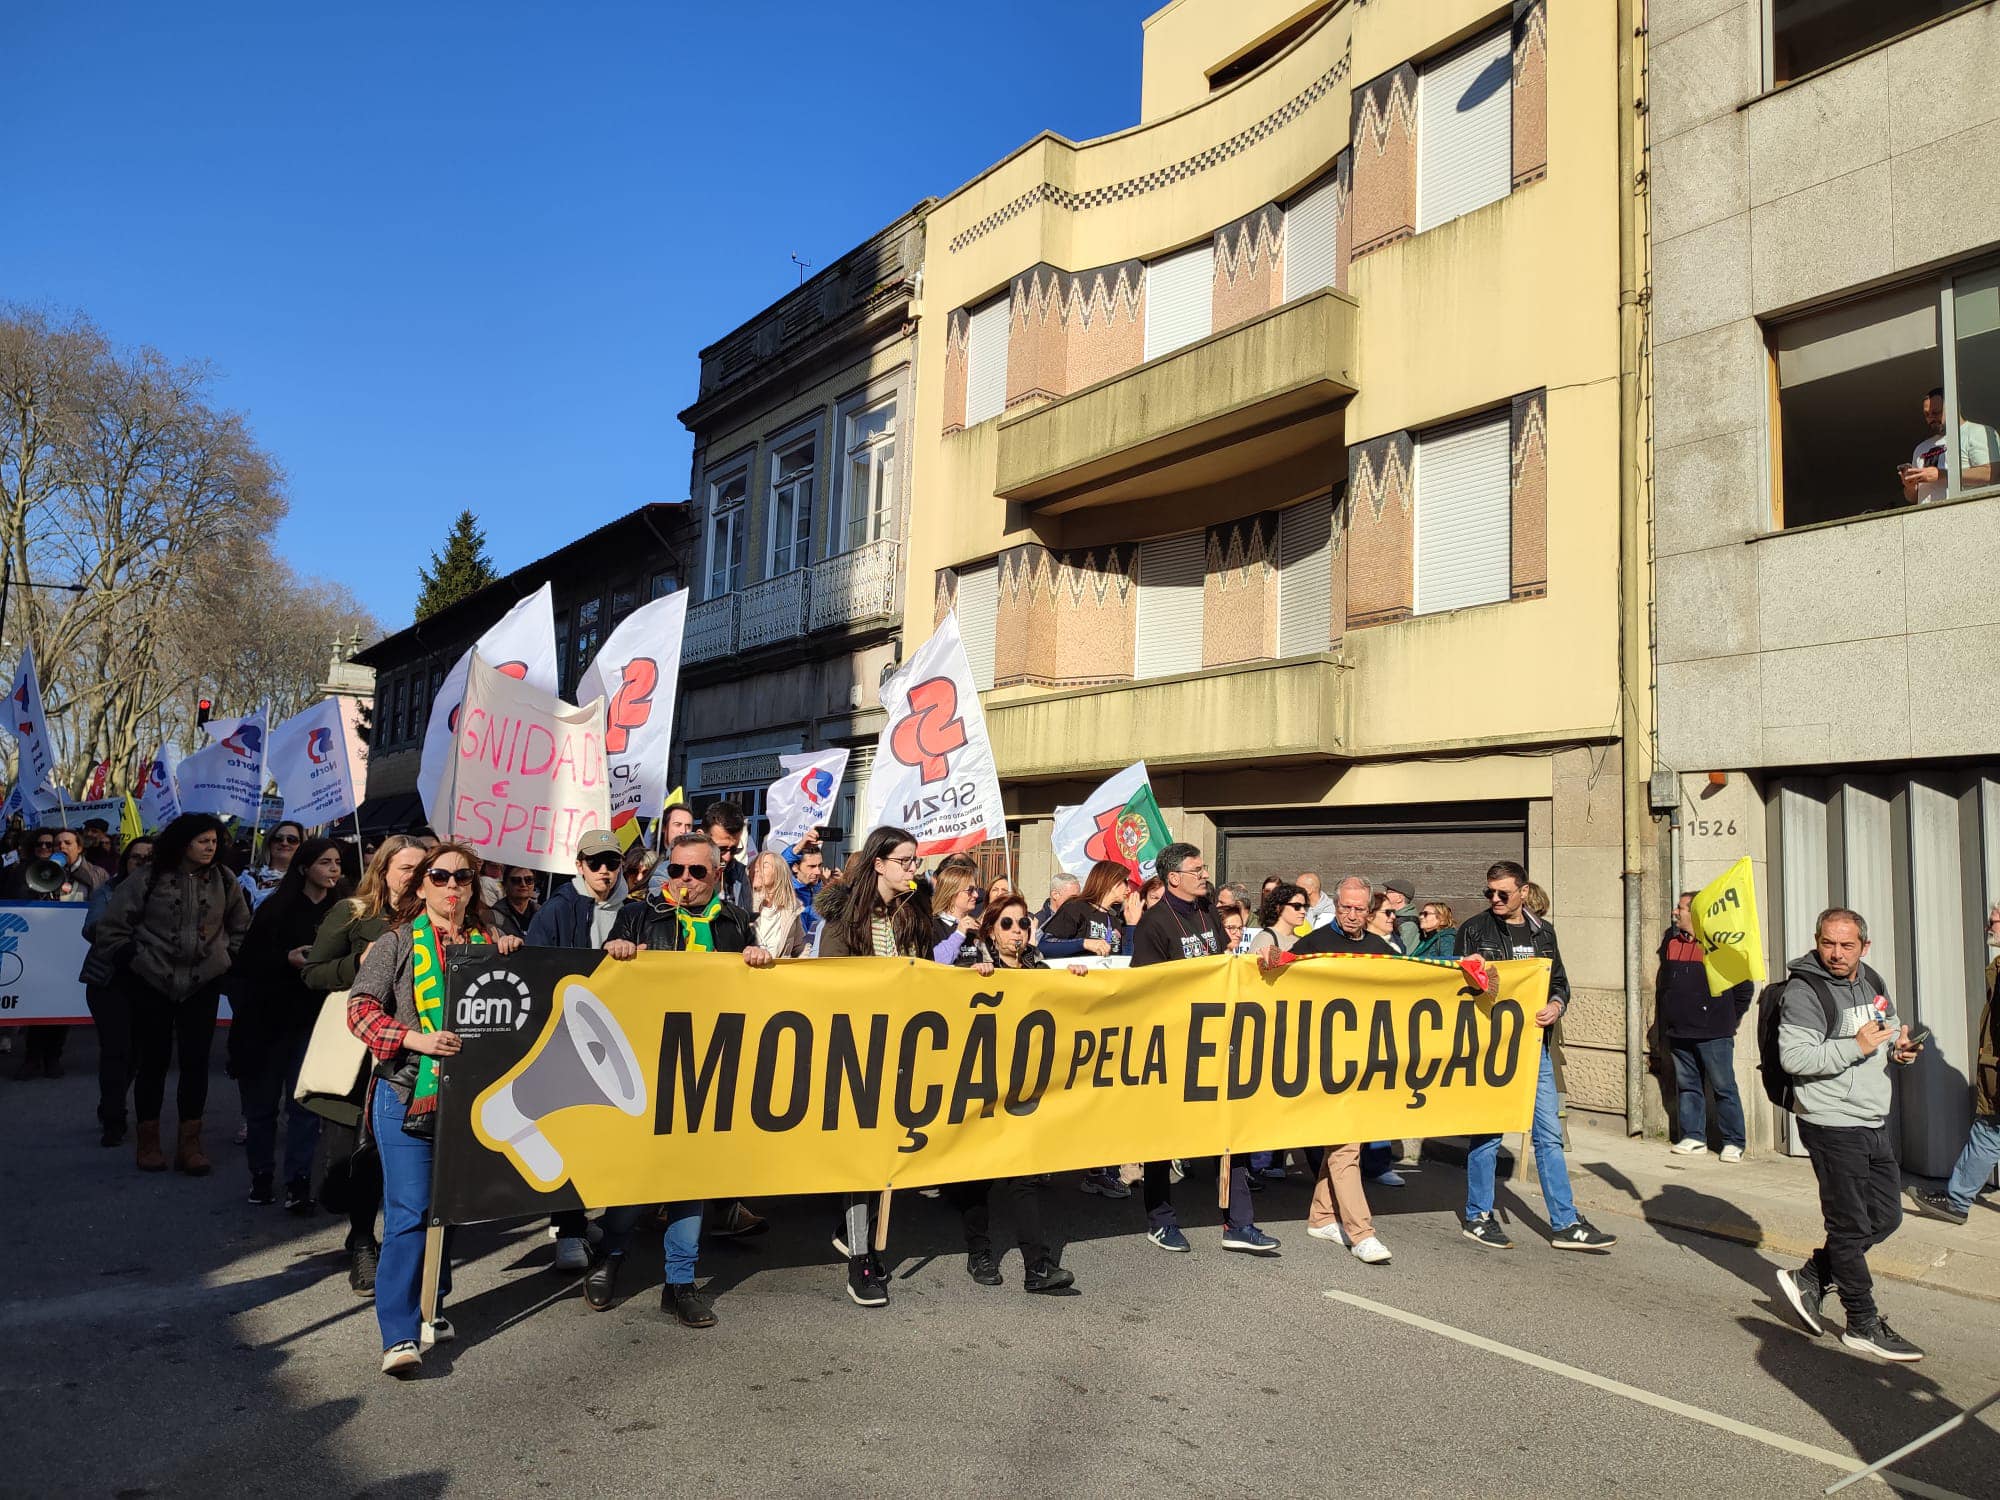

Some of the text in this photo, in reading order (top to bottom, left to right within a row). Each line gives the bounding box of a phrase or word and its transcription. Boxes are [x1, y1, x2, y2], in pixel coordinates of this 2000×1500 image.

[460, 707, 606, 787] GNIDADE
[454, 795, 599, 857] ESPEITO
[1687, 820, 1737, 836] 1526
[0, 995, 19, 1009] OF
[456, 998, 512, 1025] aem
[654, 986, 1525, 1153] MONÇÃO PELA EDUCAÇÃO
